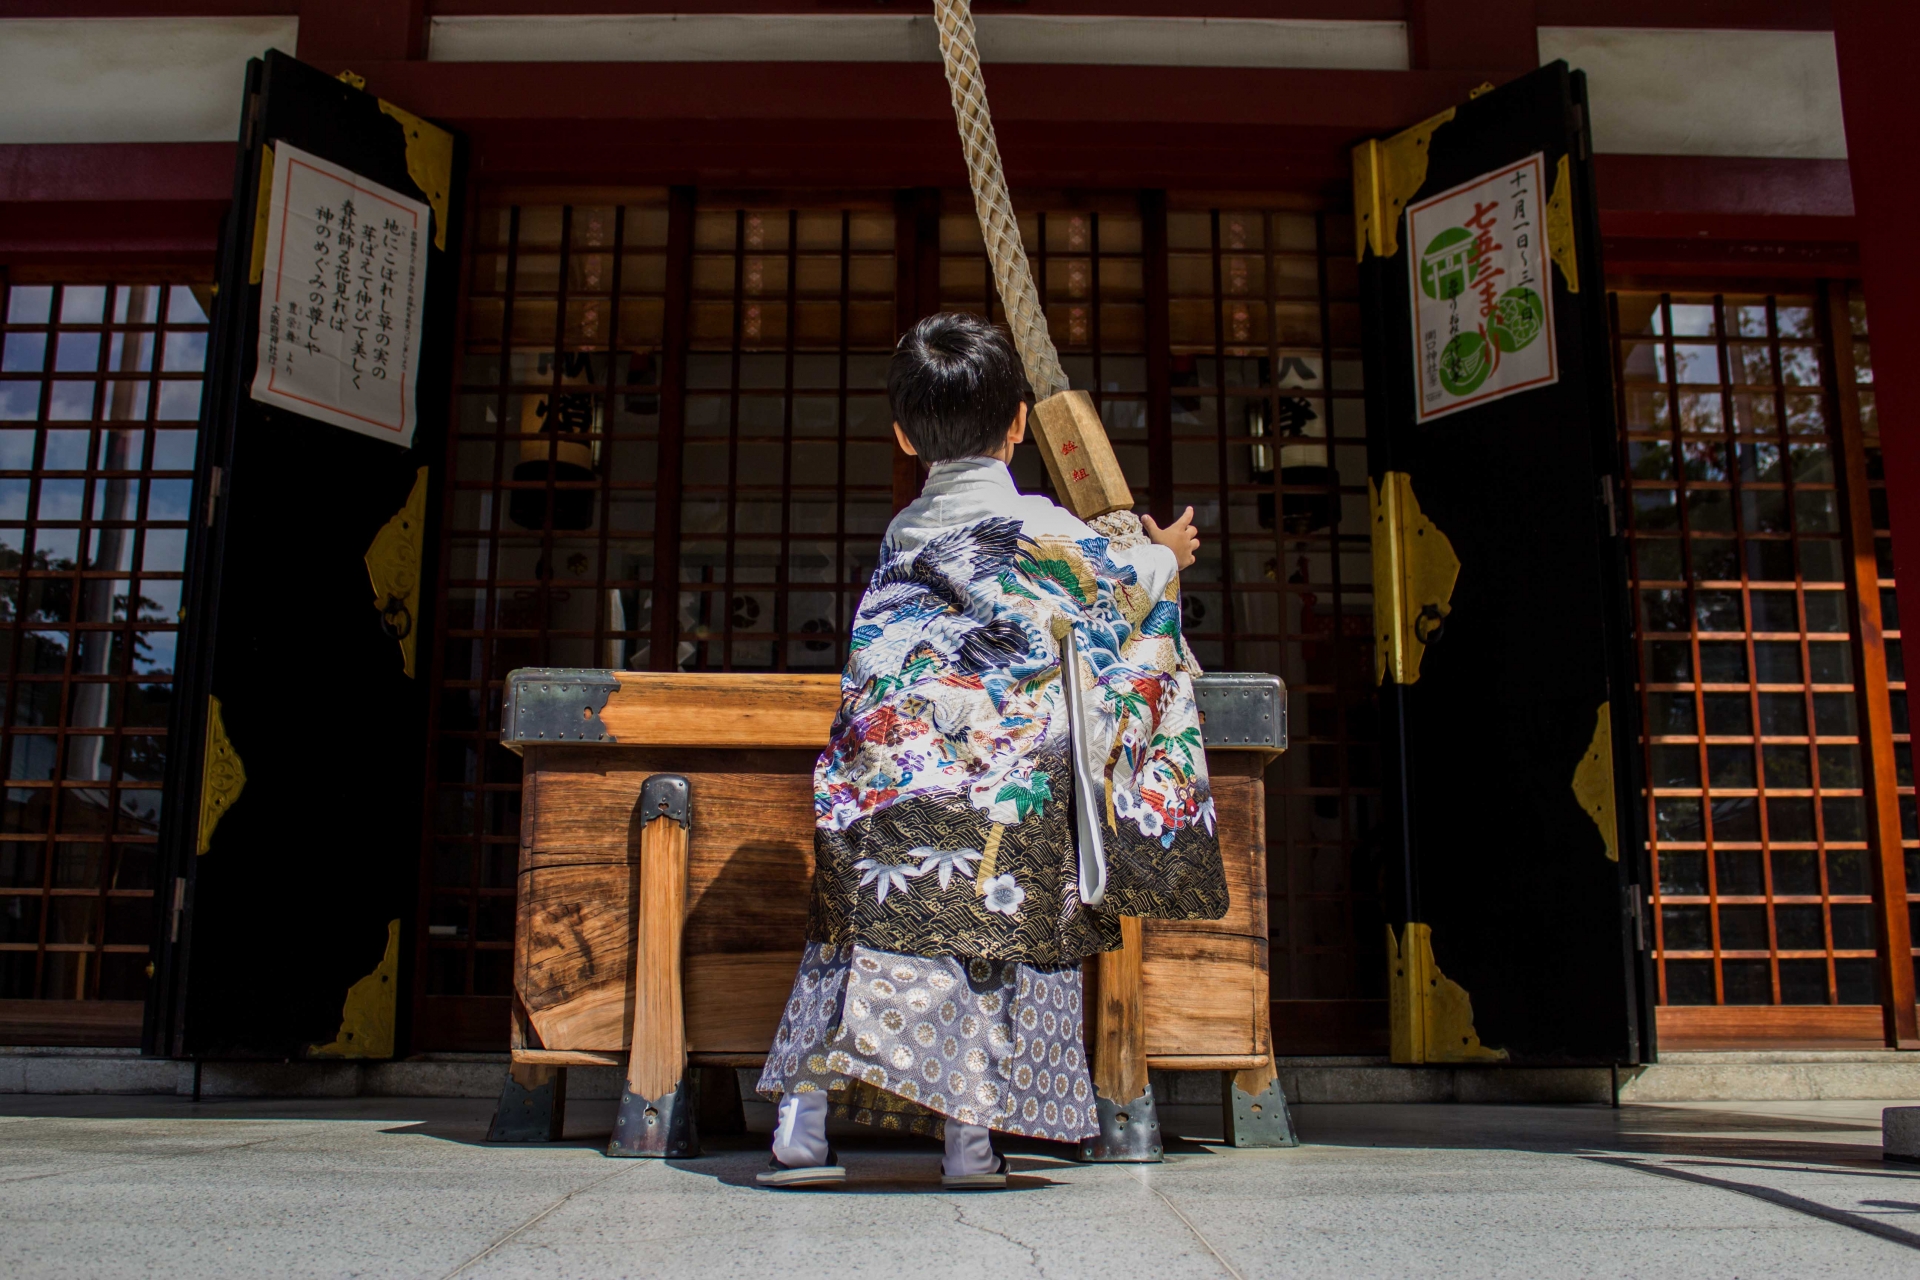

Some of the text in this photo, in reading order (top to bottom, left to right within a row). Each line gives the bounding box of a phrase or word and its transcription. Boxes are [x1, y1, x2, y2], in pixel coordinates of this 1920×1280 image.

[304, 206, 334, 356] 神のめぐみの尊しや
[329, 199, 357, 332] 春秋飾る花見れば
[350, 224, 379, 390] 芽ばえて伸びて美しく
[371, 218, 401, 380] 地にこぼれし草の実の
[1464, 201, 1505, 379] 七五三まいり
